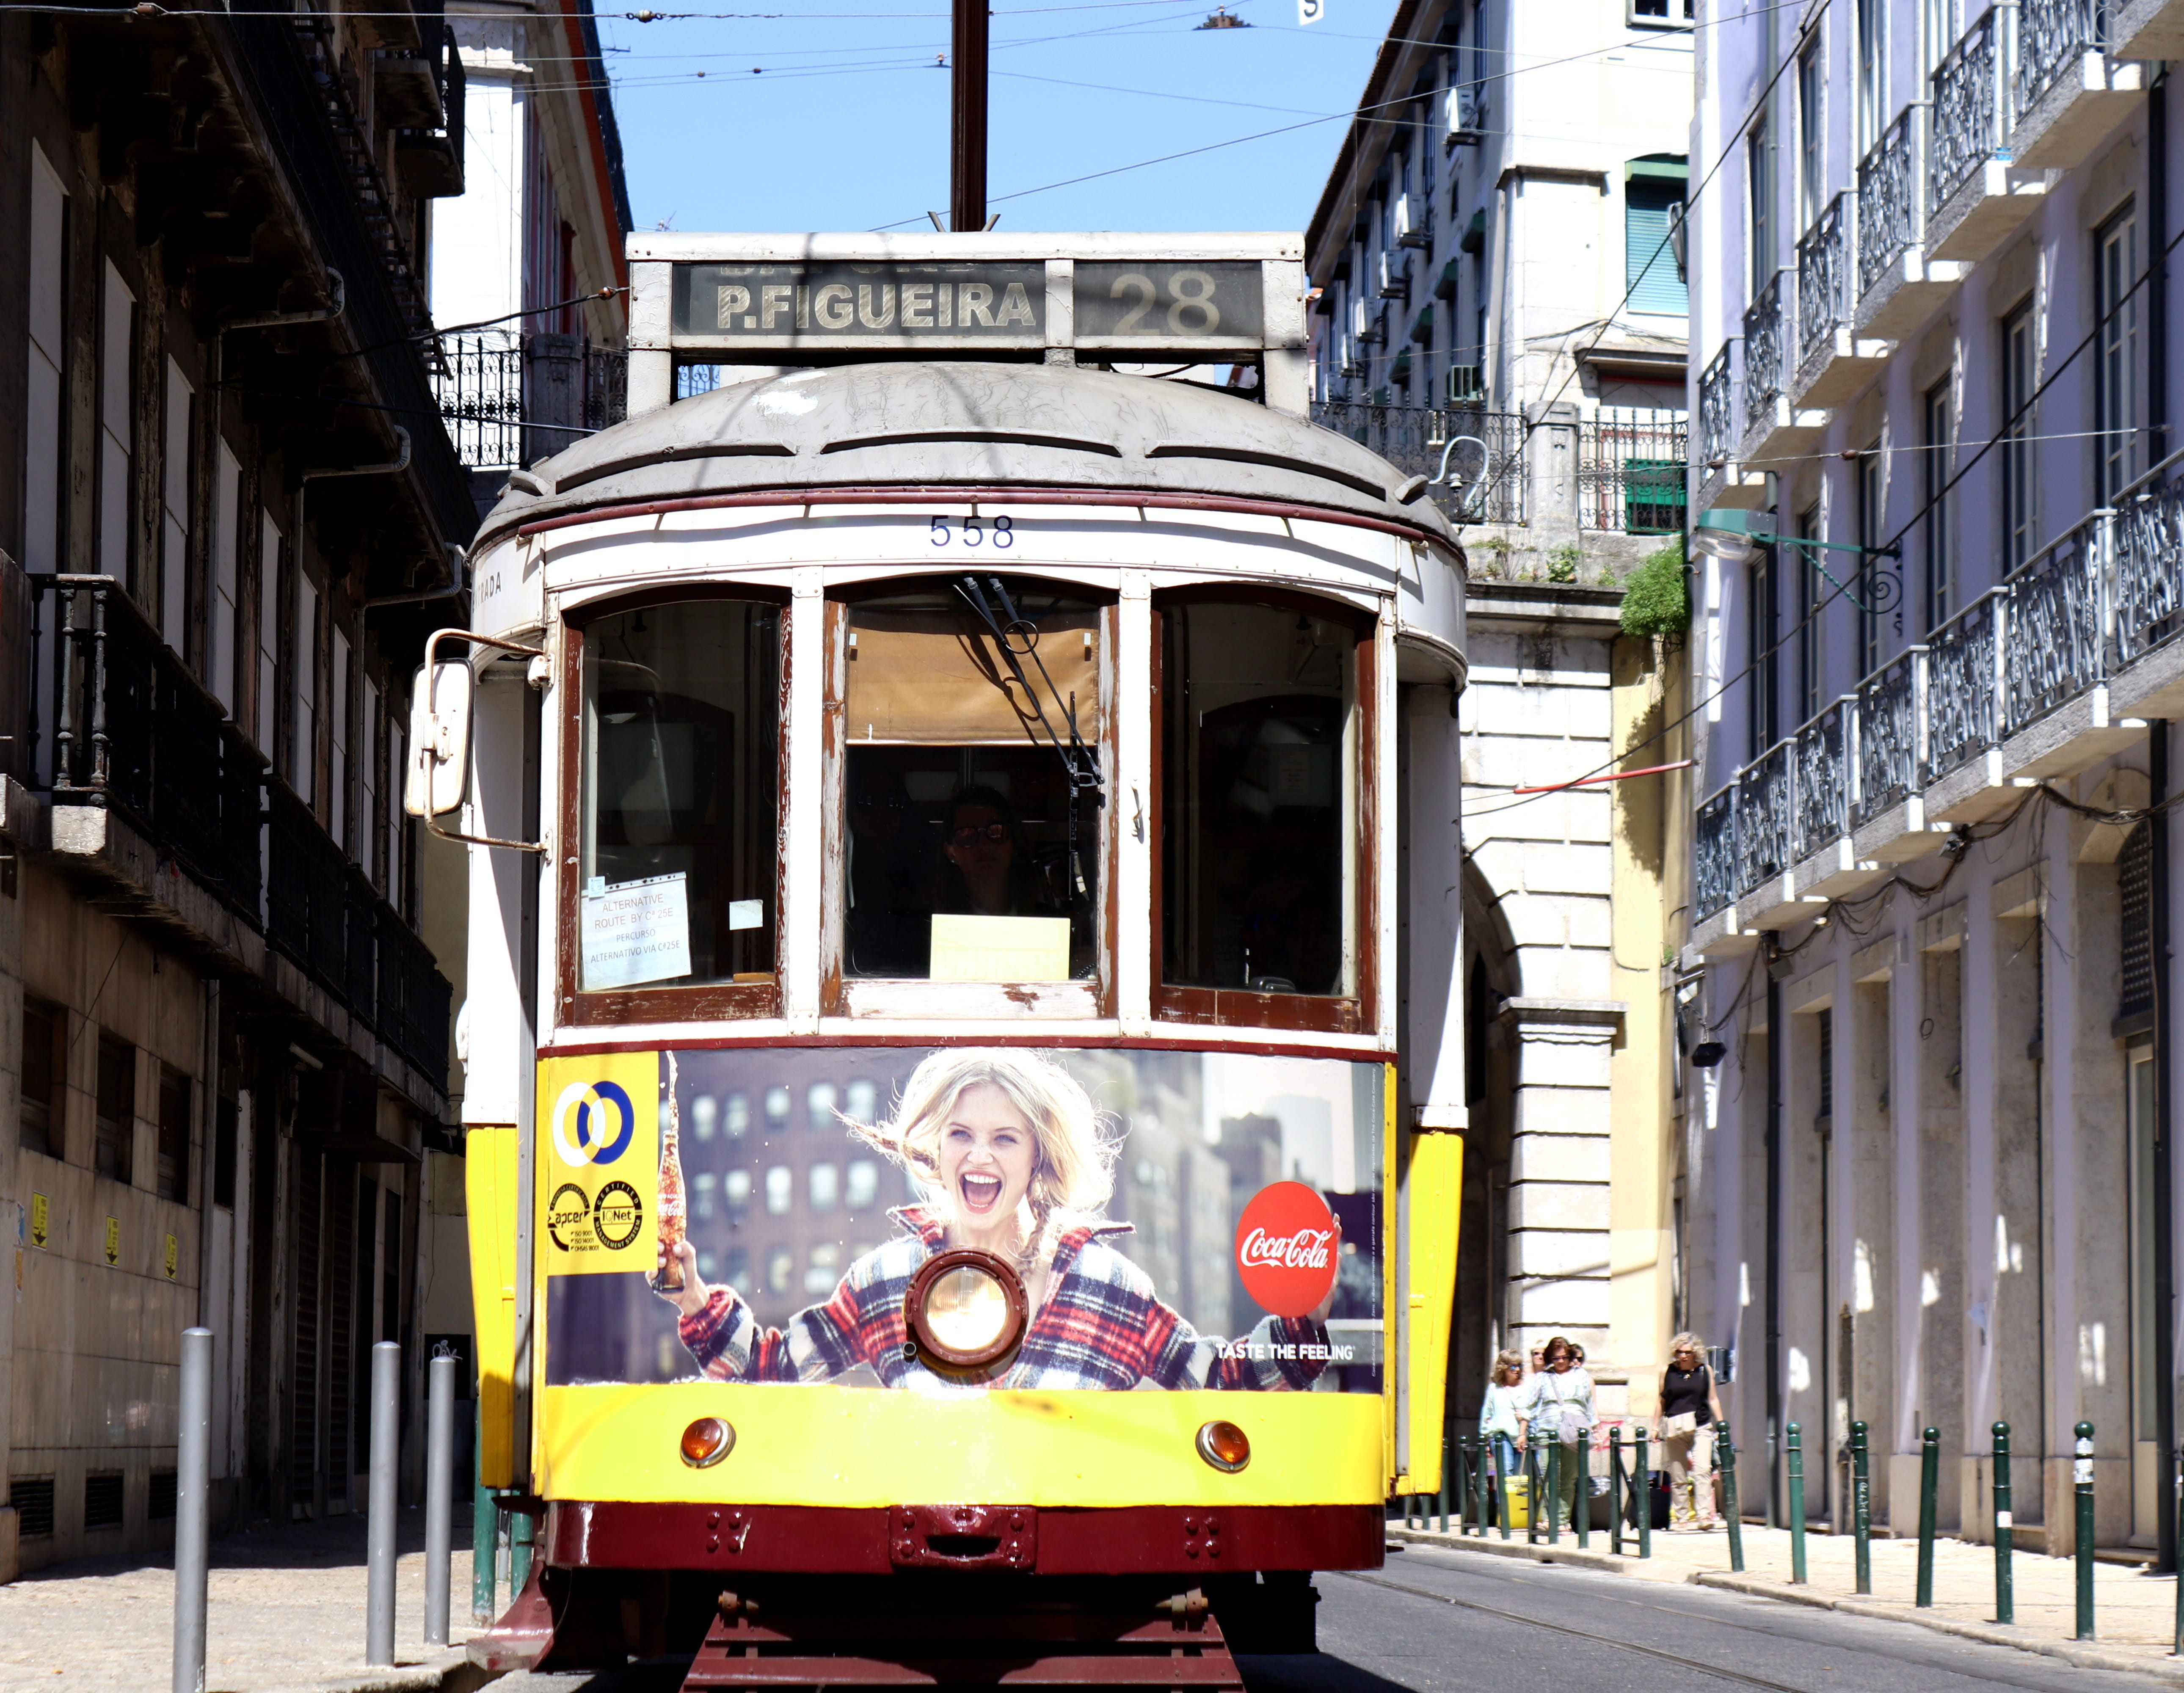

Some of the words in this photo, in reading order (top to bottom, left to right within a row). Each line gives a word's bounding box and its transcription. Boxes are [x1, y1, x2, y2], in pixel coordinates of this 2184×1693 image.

[717, 283, 1036, 328] P.FIGUEIRA
[1109, 270, 1221, 337] 28
[931, 515, 1013, 549] 558
[603, 894, 664, 913] ALTERNATIVE
[595, 915, 626, 929] ROUTE
[631, 913, 643, 923] BY
[657, 907, 673, 918] 25E
[616, 929, 655, 943] PERCURSO
[591, 947, 641, 963] ALTERNATIVO
[643, 944, 656, 954] VIA
[551, 1186, 566, 1208] EMPRESA
[597, 1183, 639, 1205] CERTIFIED
[555, 1212, 583, 1228] apcer
[596, 1220, 624, 1248] MANAGEMENT
[625, 1219, 640, 1244] SYSTEM
[1241, 1227, 1333, 1268] Coca-Cola
[1216, 1343, 1265, 1359] TASTE
[1271, 1344, 1296, 1359] THE
[1300, 1345, 1353, 1360] FEELING
